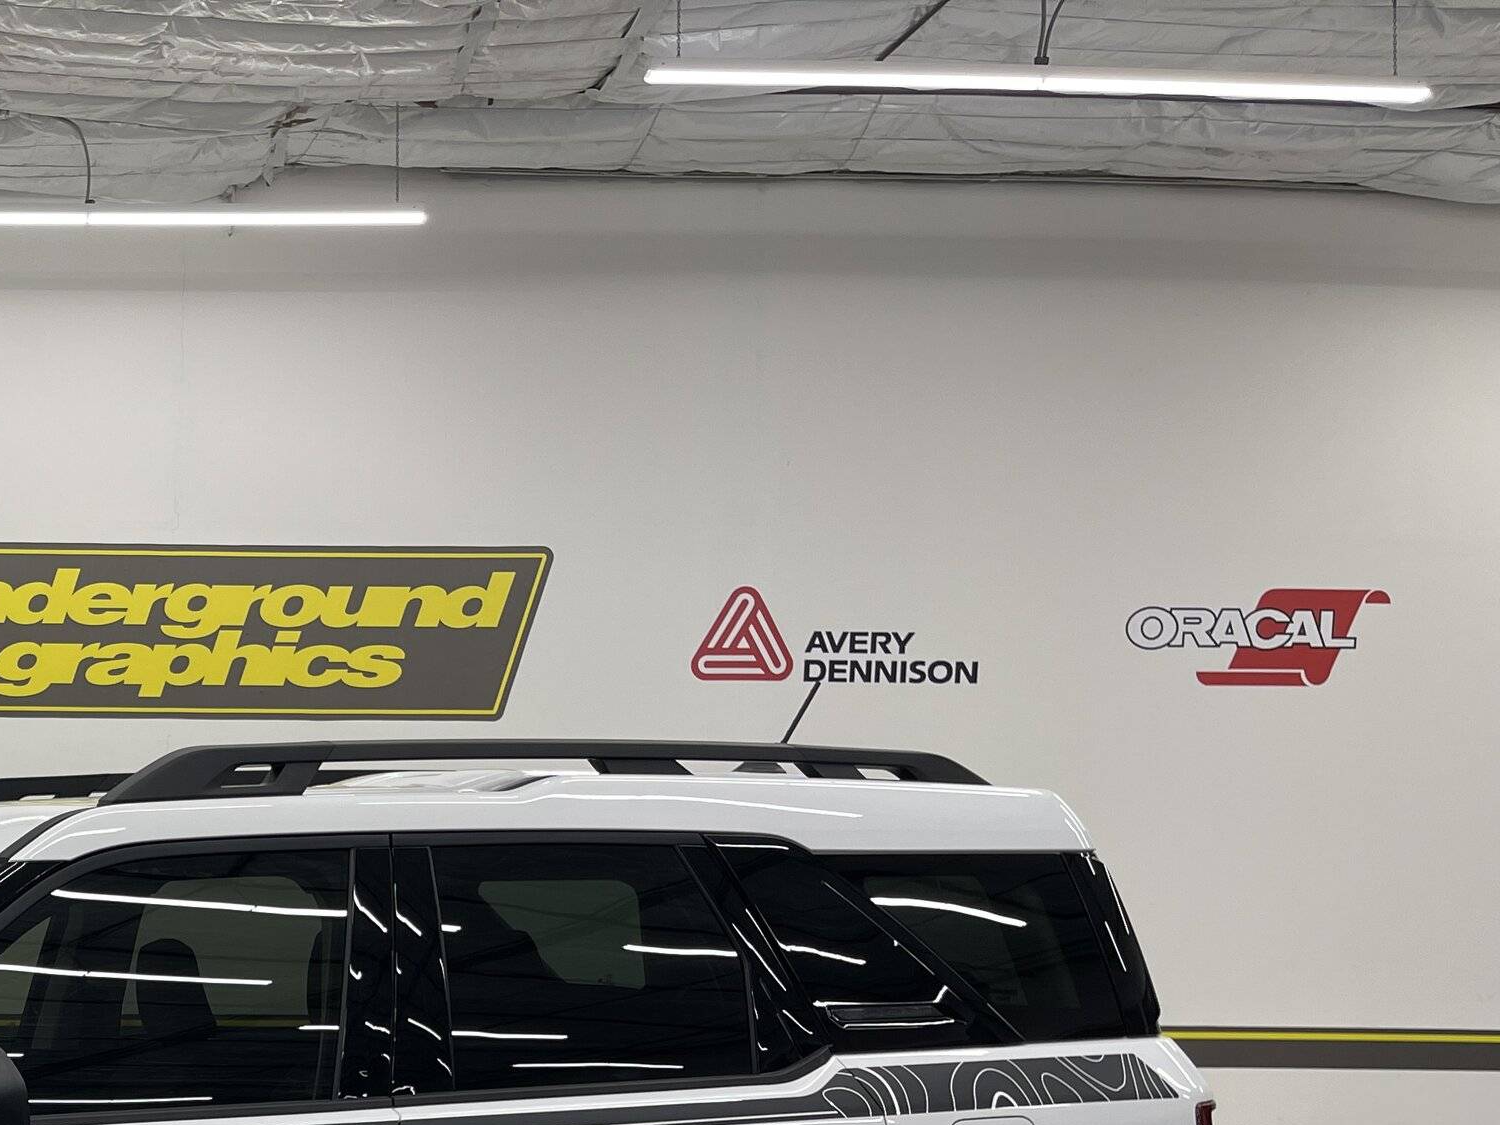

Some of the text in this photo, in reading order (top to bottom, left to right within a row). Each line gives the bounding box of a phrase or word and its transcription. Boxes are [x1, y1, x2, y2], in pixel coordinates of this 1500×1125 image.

[1125, 606, 1357, 650] ORACAL
[804, 630, 915, 655] AVERY
[802, 659, 979, 684] DENNISON
